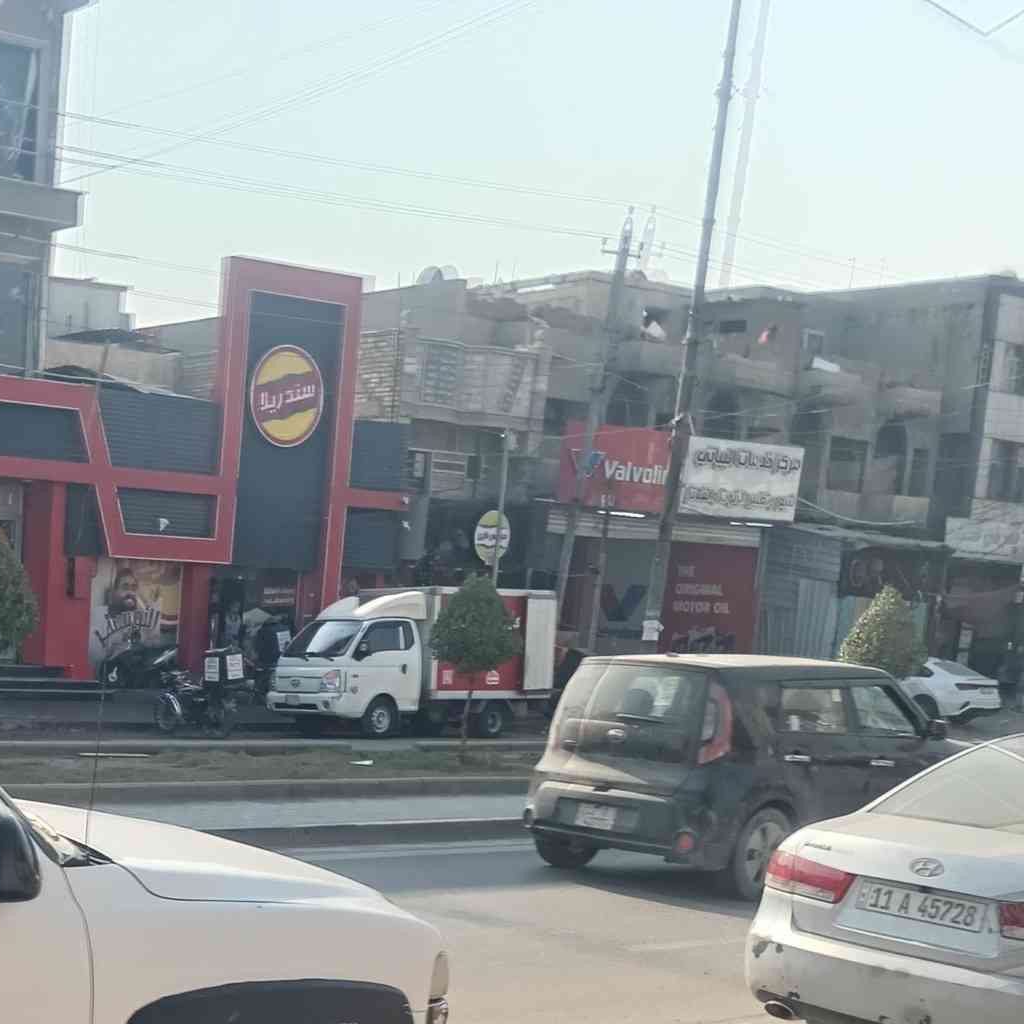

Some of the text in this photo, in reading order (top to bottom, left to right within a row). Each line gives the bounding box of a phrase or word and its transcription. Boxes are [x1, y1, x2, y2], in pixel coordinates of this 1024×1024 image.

[260, 383, 316, 414] سندريلا
[603, 459, 669, 486] Valvoli
[771, 455, 801, 475] مركز
[869, 886, 977, 928] 11 A 45728
